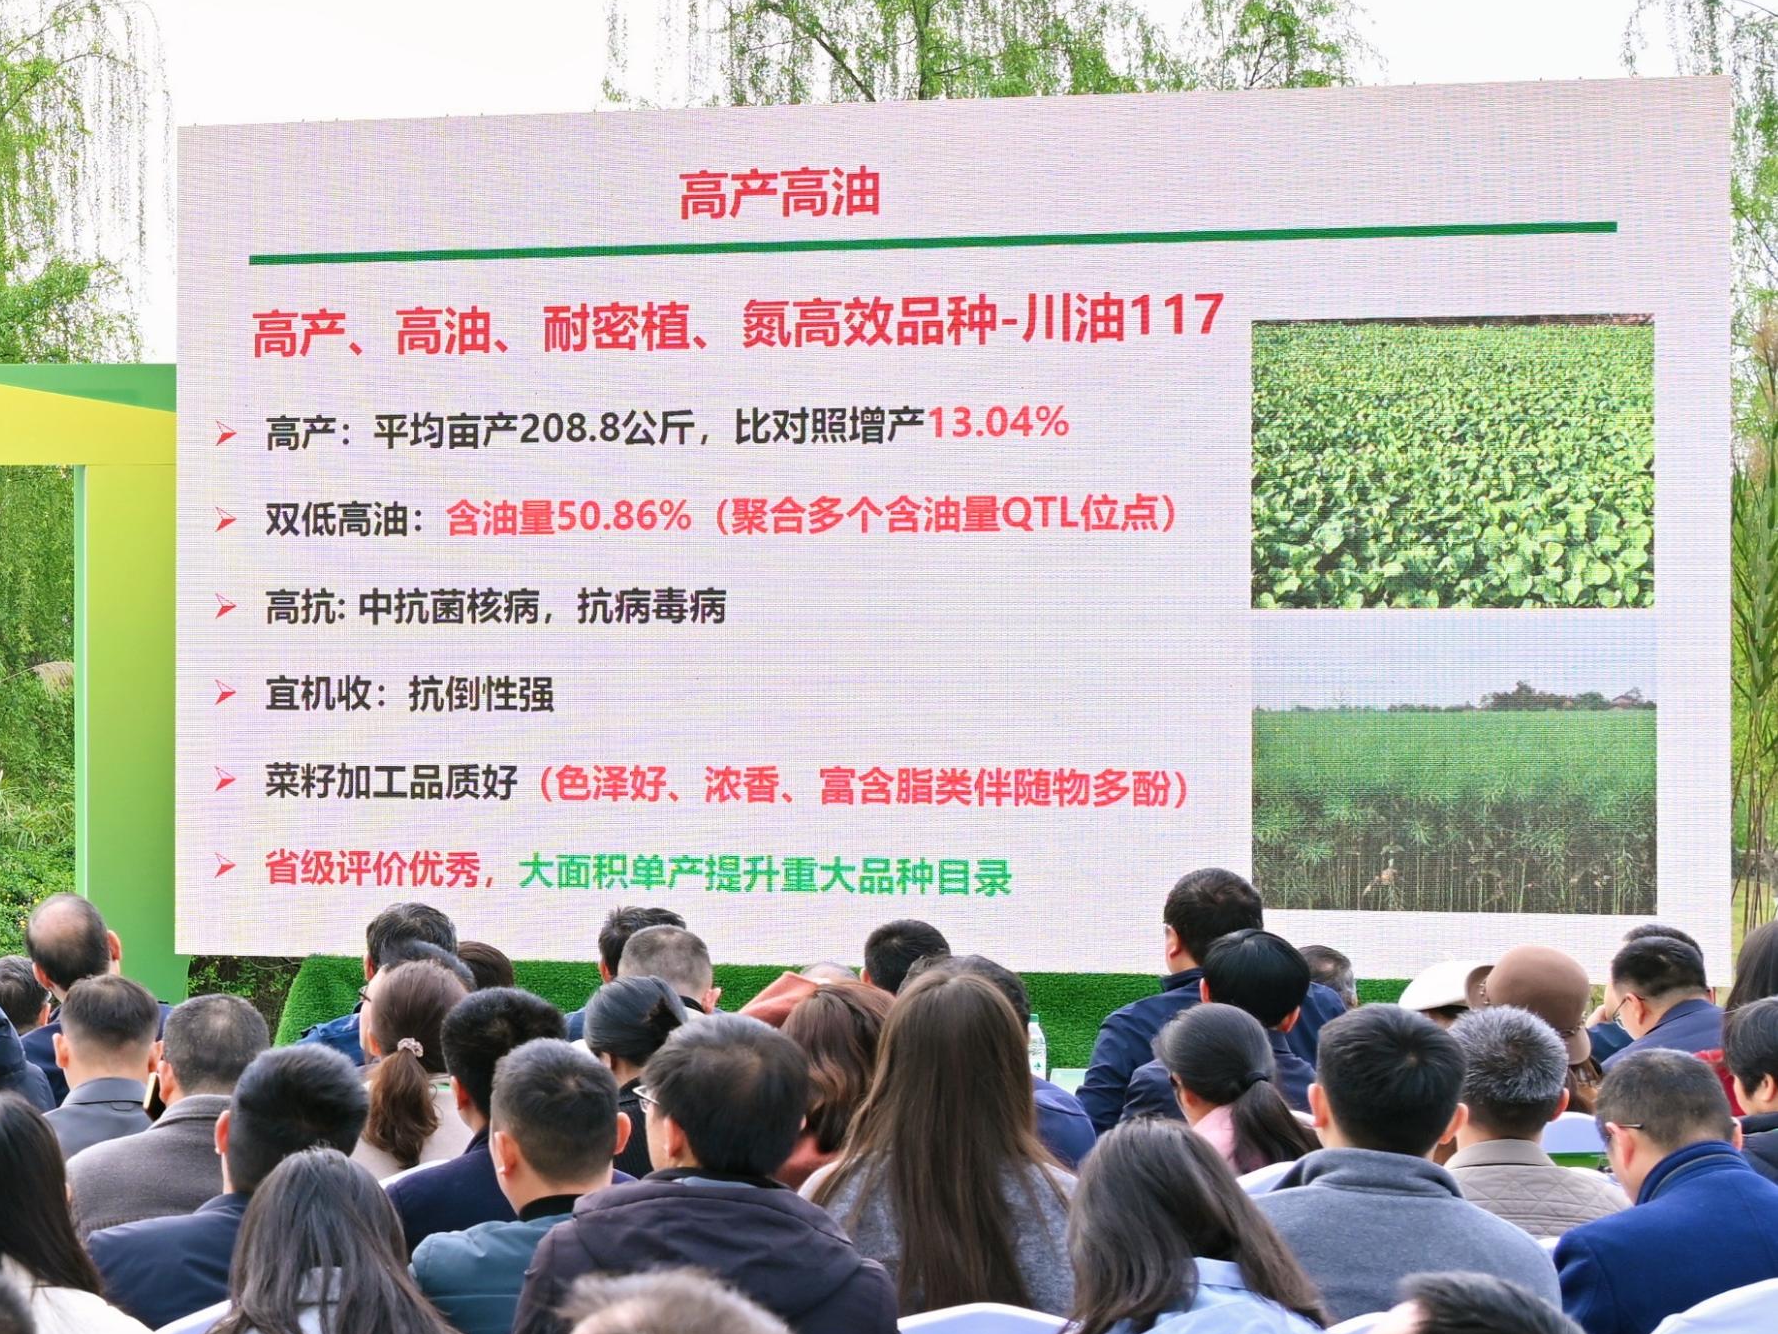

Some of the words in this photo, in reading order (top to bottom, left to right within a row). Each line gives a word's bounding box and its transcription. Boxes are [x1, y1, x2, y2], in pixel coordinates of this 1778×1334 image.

[679, 166, 881, 220] 高产高油
[252, 292, 1225, 358] 高产、高油、耐密植、氮高效品种-川油117
[264, 675, 555, 714] 宜机收：抗倒性强
